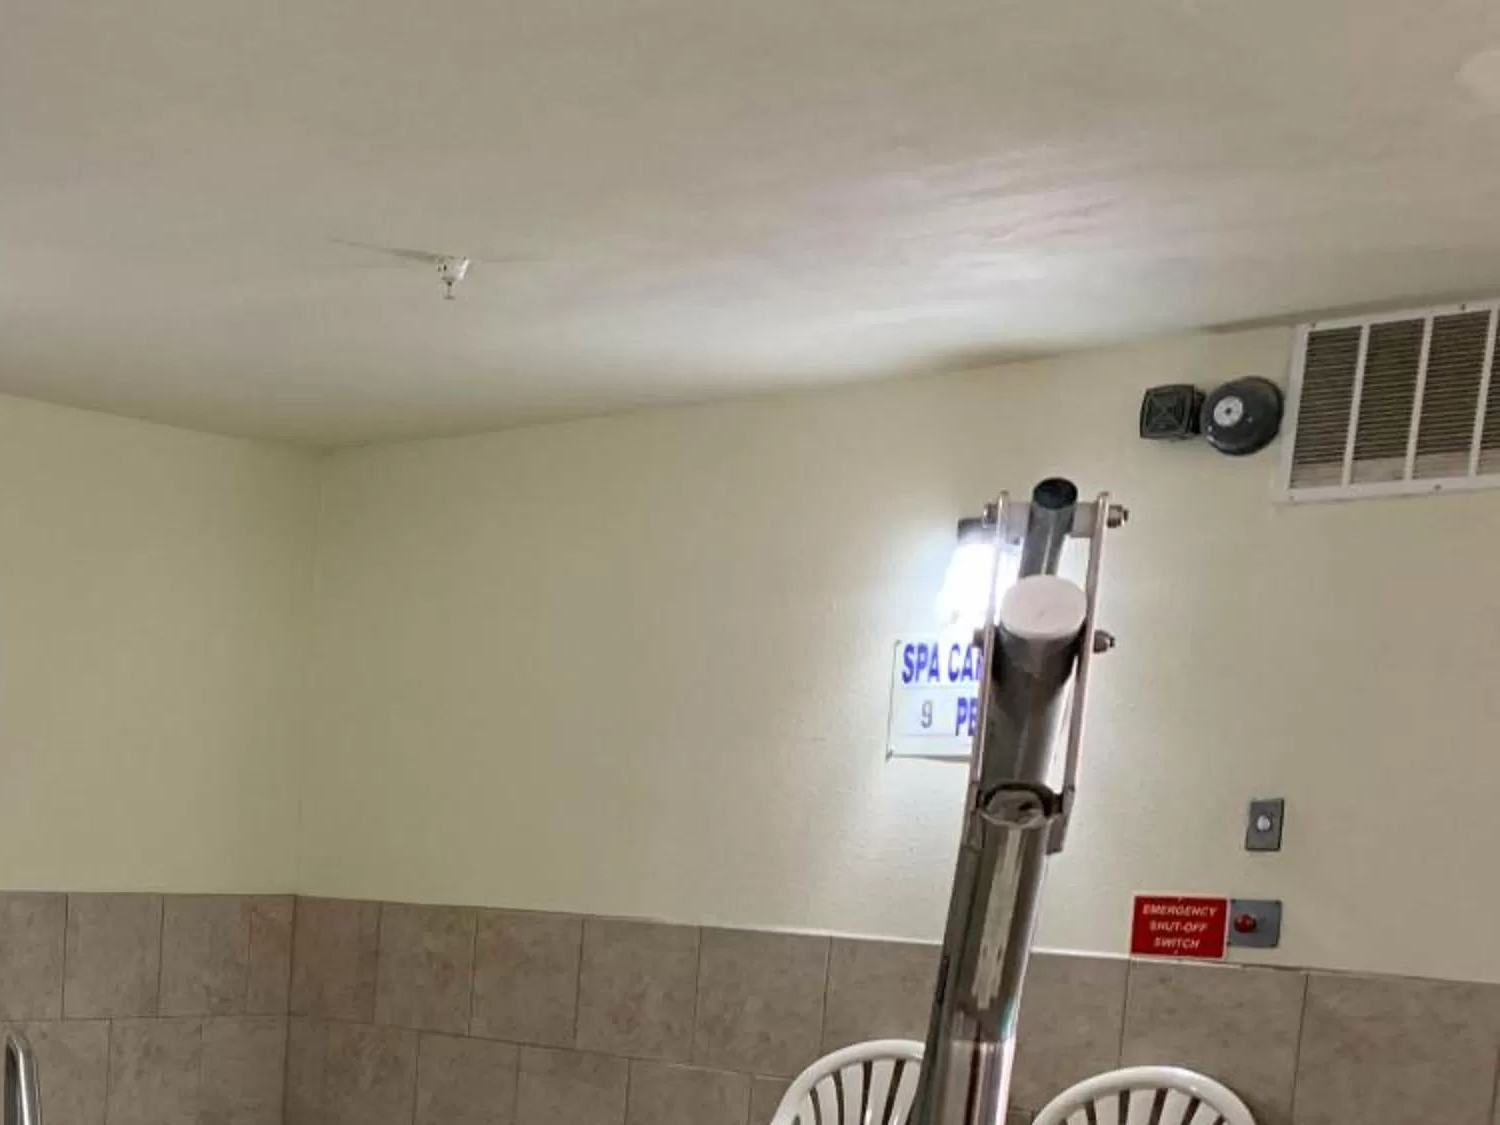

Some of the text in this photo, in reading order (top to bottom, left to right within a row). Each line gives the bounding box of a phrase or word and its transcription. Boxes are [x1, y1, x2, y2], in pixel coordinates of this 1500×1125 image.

[902, 643, 941, 684] SPA
[921, 700, 933, 728] 9
[1142, 904, 1218, 917] EMERGENCY
[1154, 937, 1200, 949] SWITCH
